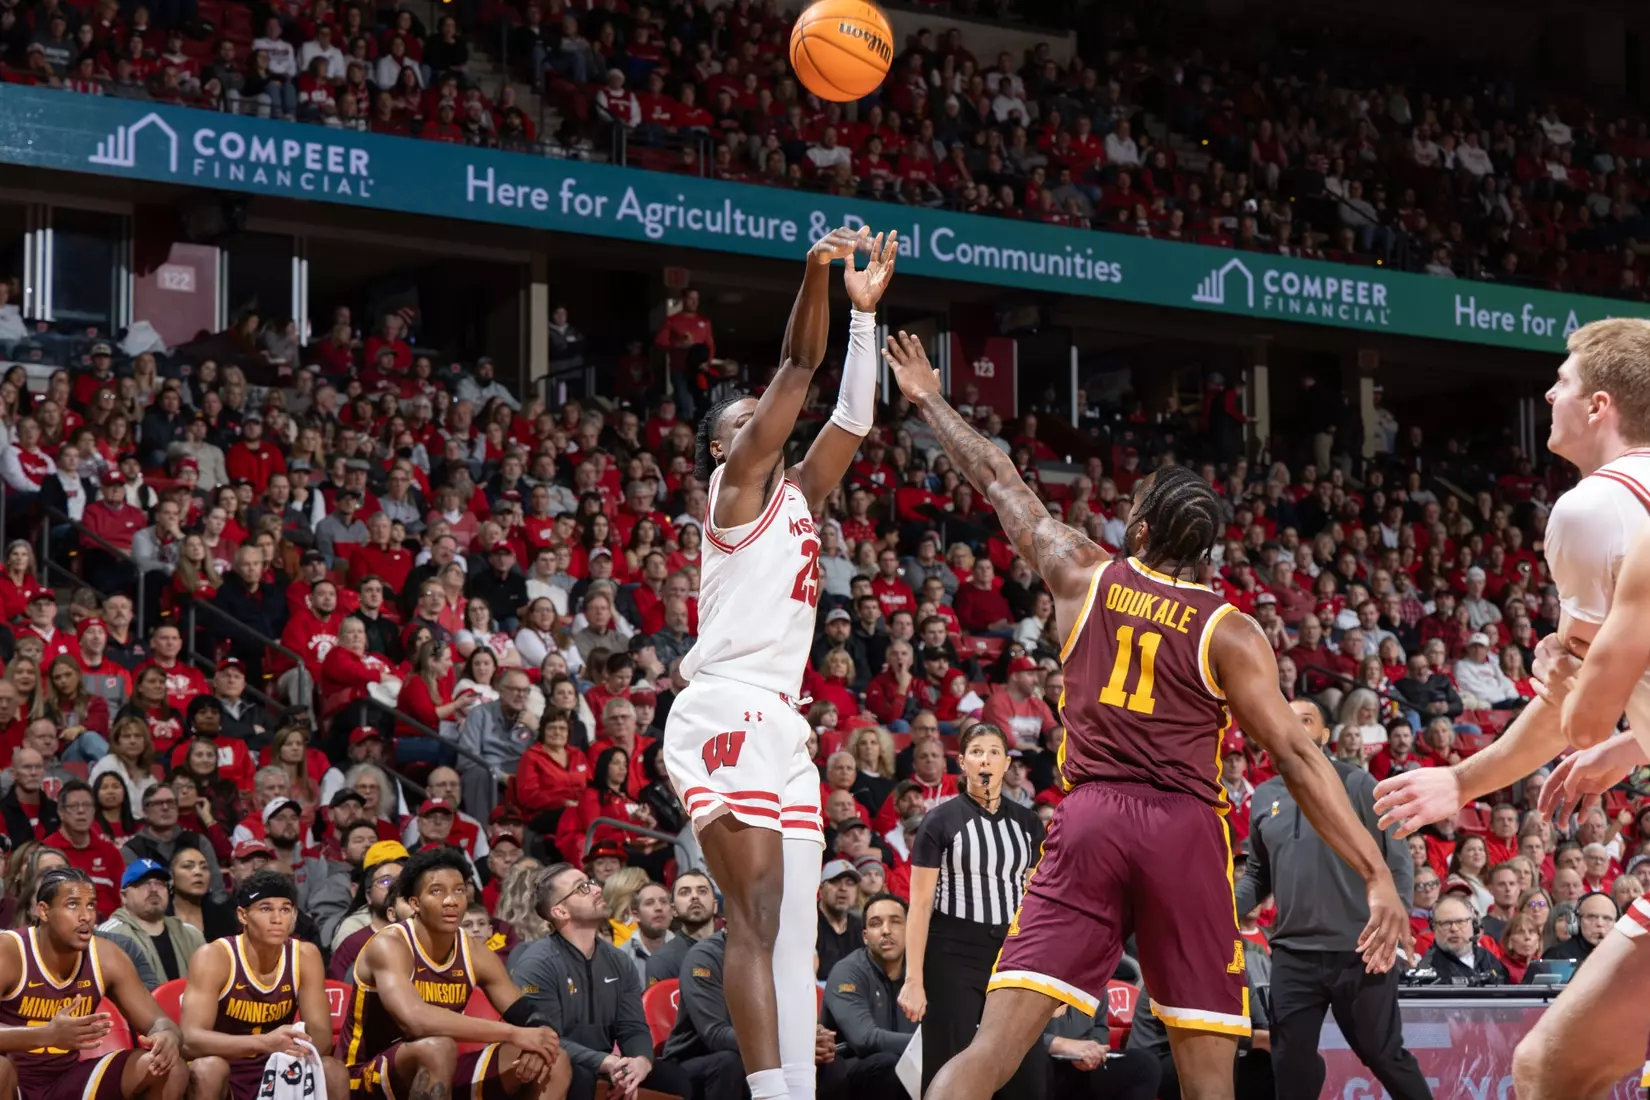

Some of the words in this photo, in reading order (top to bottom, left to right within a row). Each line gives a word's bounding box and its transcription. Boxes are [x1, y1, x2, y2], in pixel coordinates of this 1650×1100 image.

[193, 128, 369, 177] COMPEER
[193, 158, 370, 198] FINANCIAL
[466, 164, 550, 211] Here
[559, 178, 609, 218] for
[616, 186, 798, 242] Agriculture
[930, 227, 1122, 283] Communities
[1263, 269, 1388, 307] COMPEER
[1264, 294, 1388, 325] FINANCIAL
[1454, 294, 1515, 332] Here
[1521, 303, 1557, 337] for
[1106, 583, 1198, 634] ODUKALE
[1098, 624, 1163, 715] 11
[702, 731, 747, 777] W
[225, 996, 293, 1024] MINNESOTA
